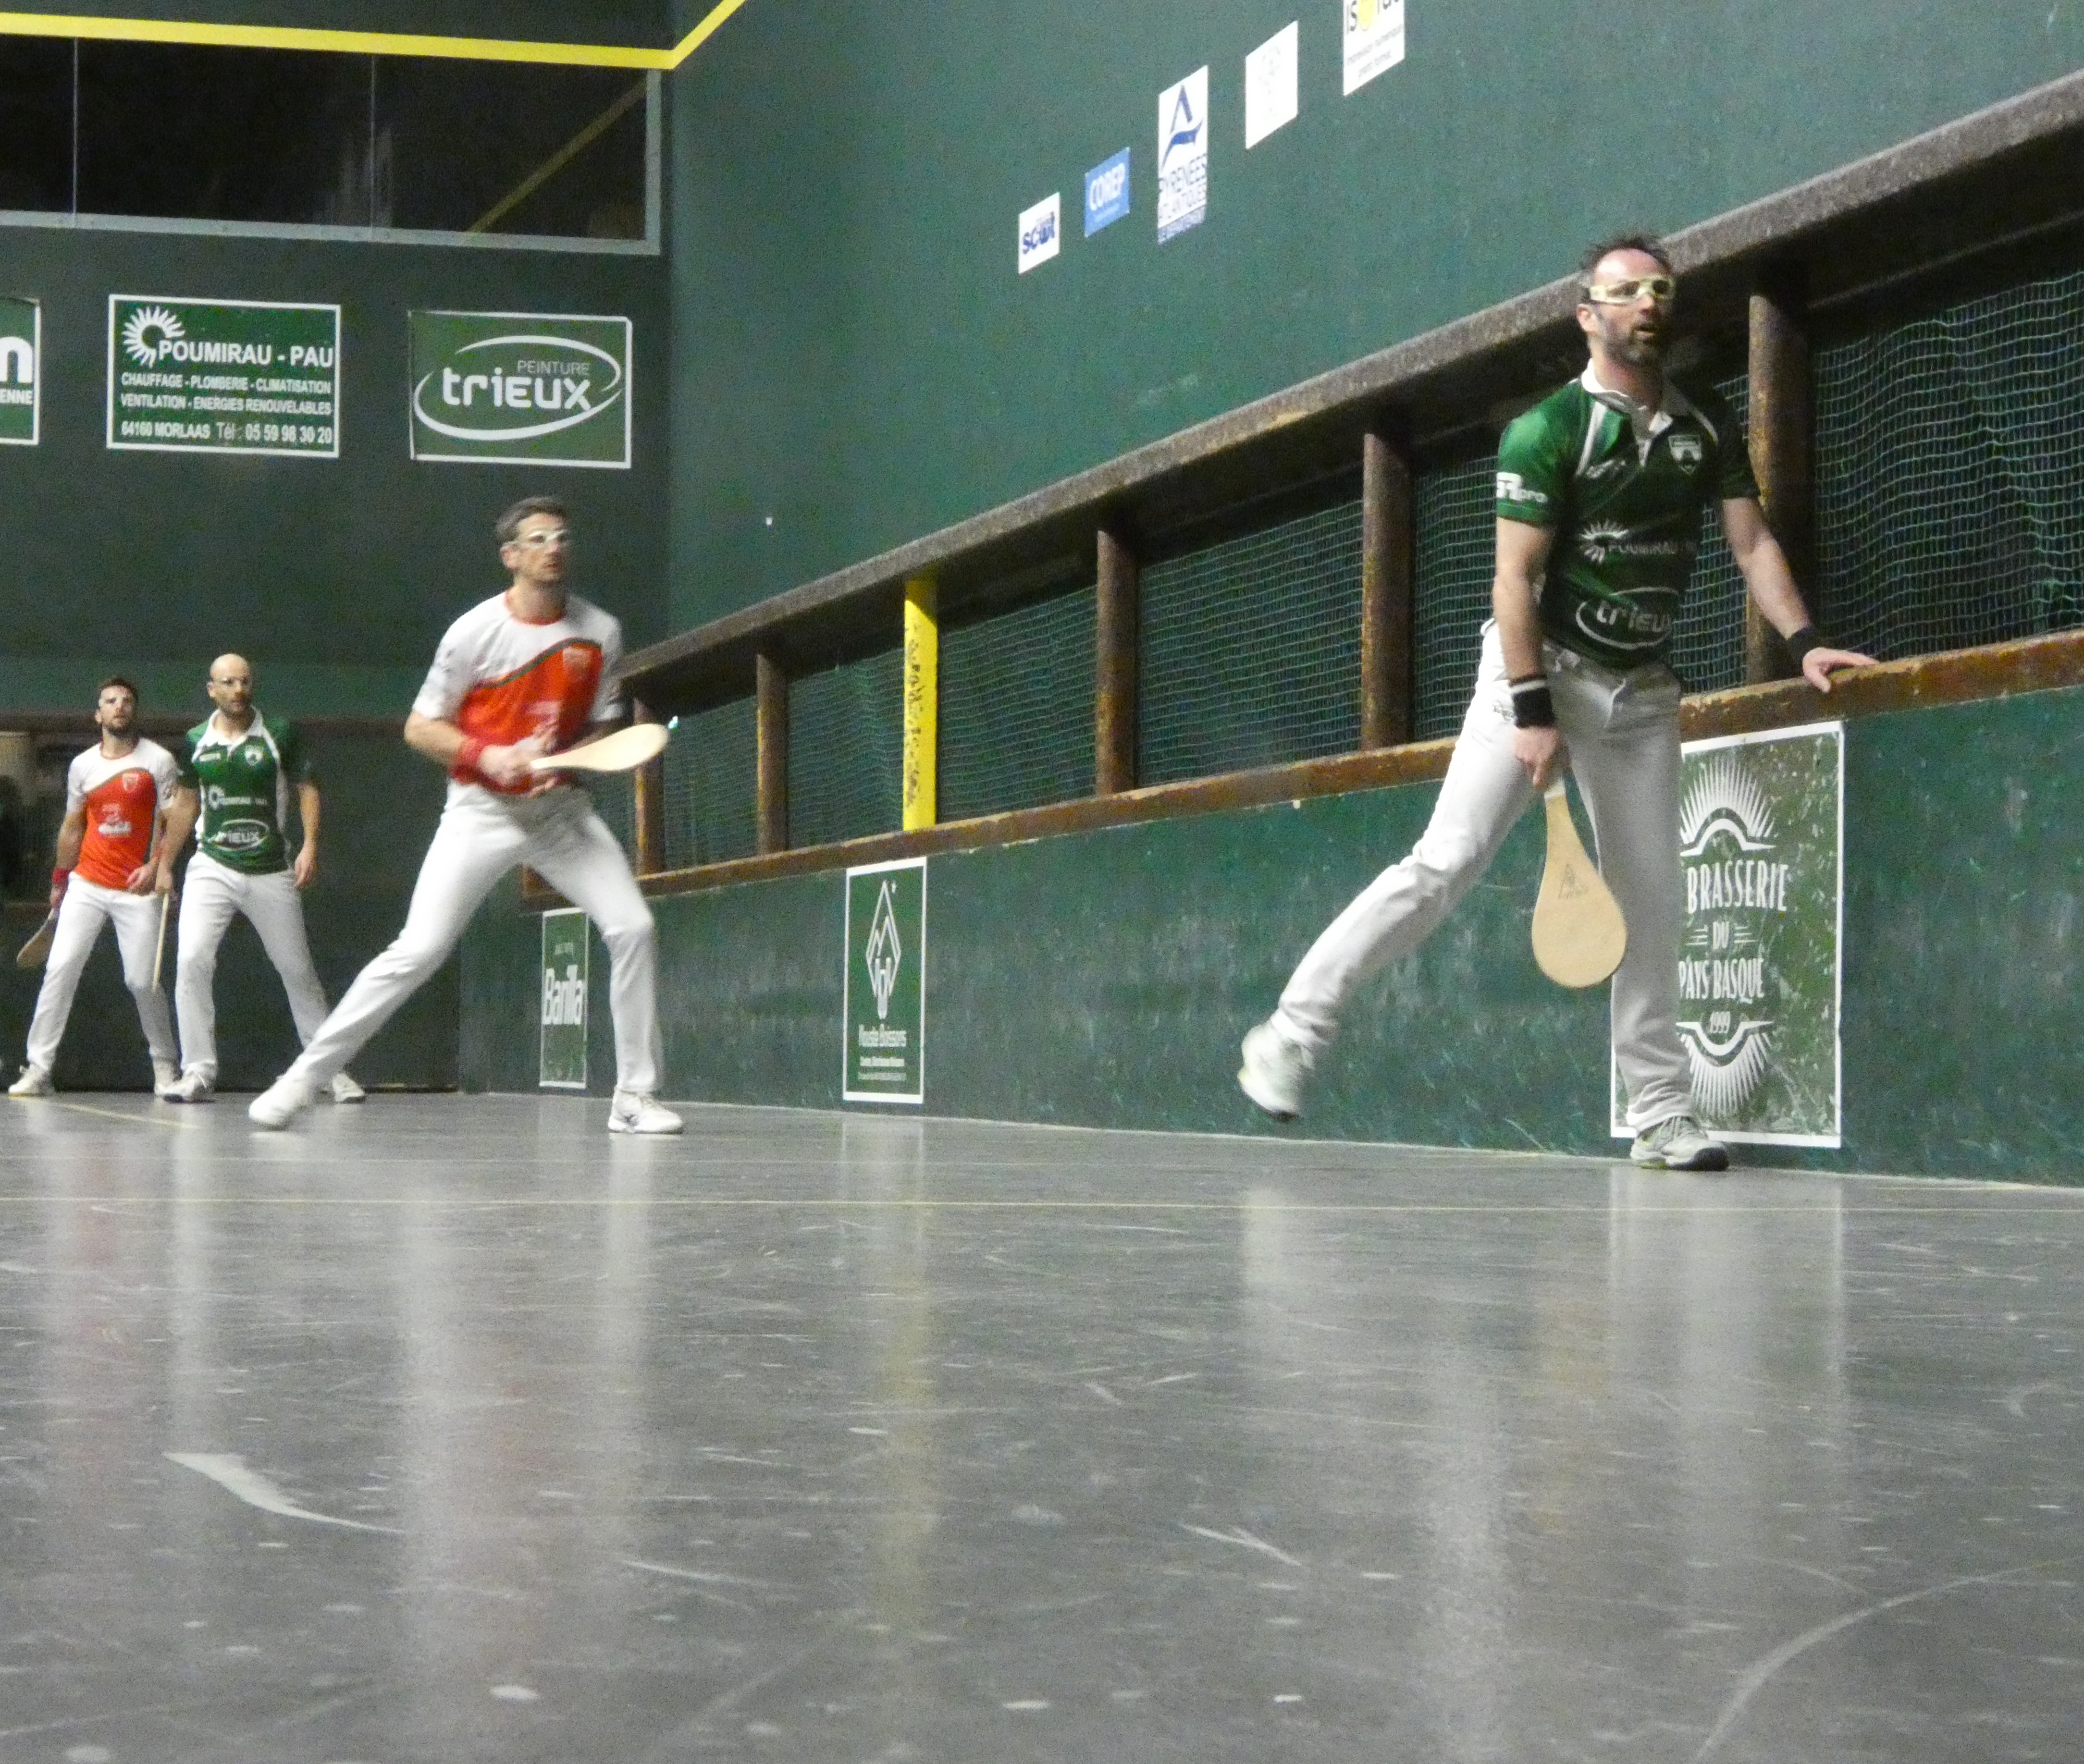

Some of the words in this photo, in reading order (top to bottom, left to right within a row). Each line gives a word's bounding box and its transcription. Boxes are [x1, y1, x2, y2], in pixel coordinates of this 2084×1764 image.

[159, 340, 272, 365] POUMIRAU
[290, 345, 333, 368] PAU
[517, 359, 590, 376] PEINTURE
[121, 372, 183, 388] CHAUFFAGE
[190, 375, 248, 391] PLOMBERIE
[255, 378, 332, 394] CLIMATISATION
[121, 393, 186, 409] VENTILATION
[245, 398, 332, 416] RENOUVELABLES
[154, 422, 211, 439] MORLAAS
[245, 423, 261, 441] 05
[299, 426, 315, 443] 30
[317, 427, 333, 444] 20
[1687, 859, 1788, 915] BRASSERIE
[1712, 920, 1730, 950] DU
[1678, 959, 1709, 999] PAYS
[1713, 957, 1764, 1004] BASQUE
